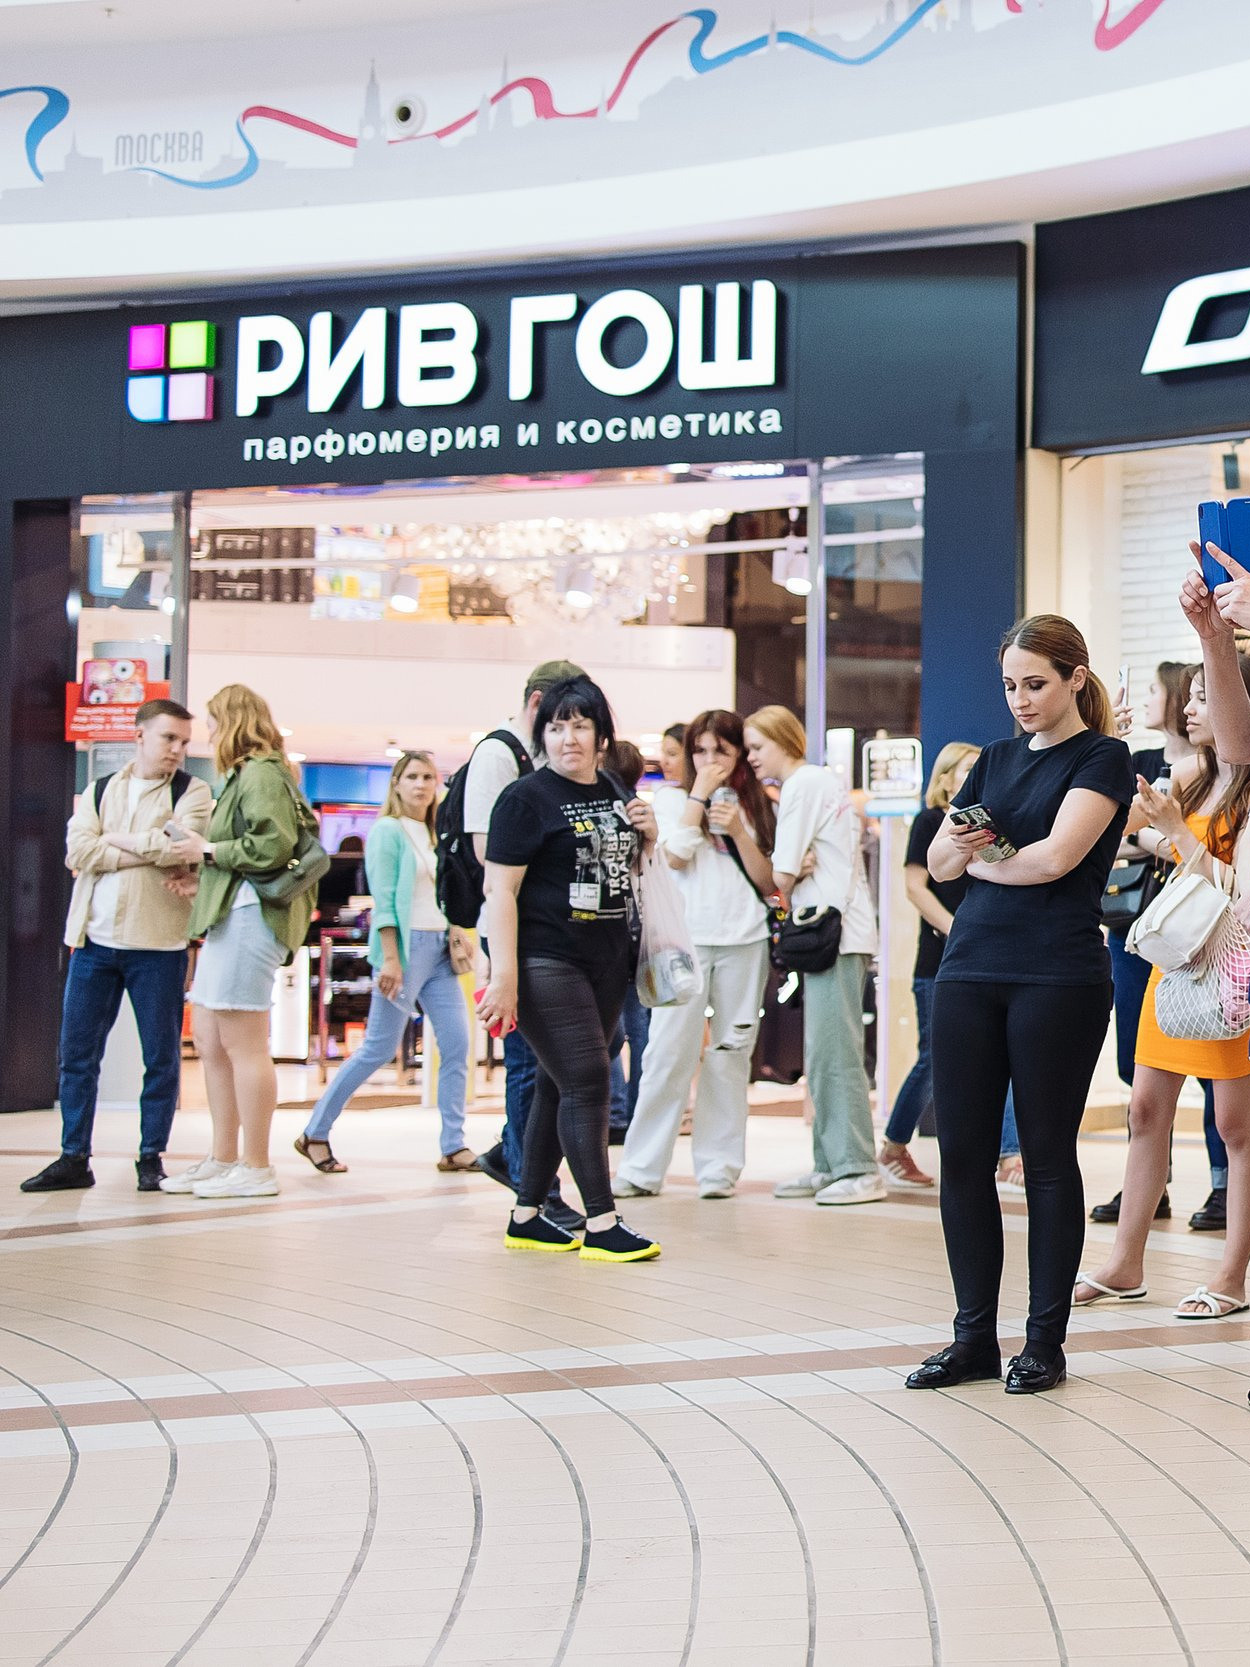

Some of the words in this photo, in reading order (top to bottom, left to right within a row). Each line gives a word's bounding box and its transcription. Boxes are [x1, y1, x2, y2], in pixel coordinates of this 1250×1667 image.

[114, 130, 204, 166] МОСКВА
[236, 302, 480, 418] РИВ
[508, 279, 778, 403] ГОШ
[243, 423, 500, 465] парфюмерия
[517, 424, 539, 447] и
[556, 408, 783, 445] косметика
